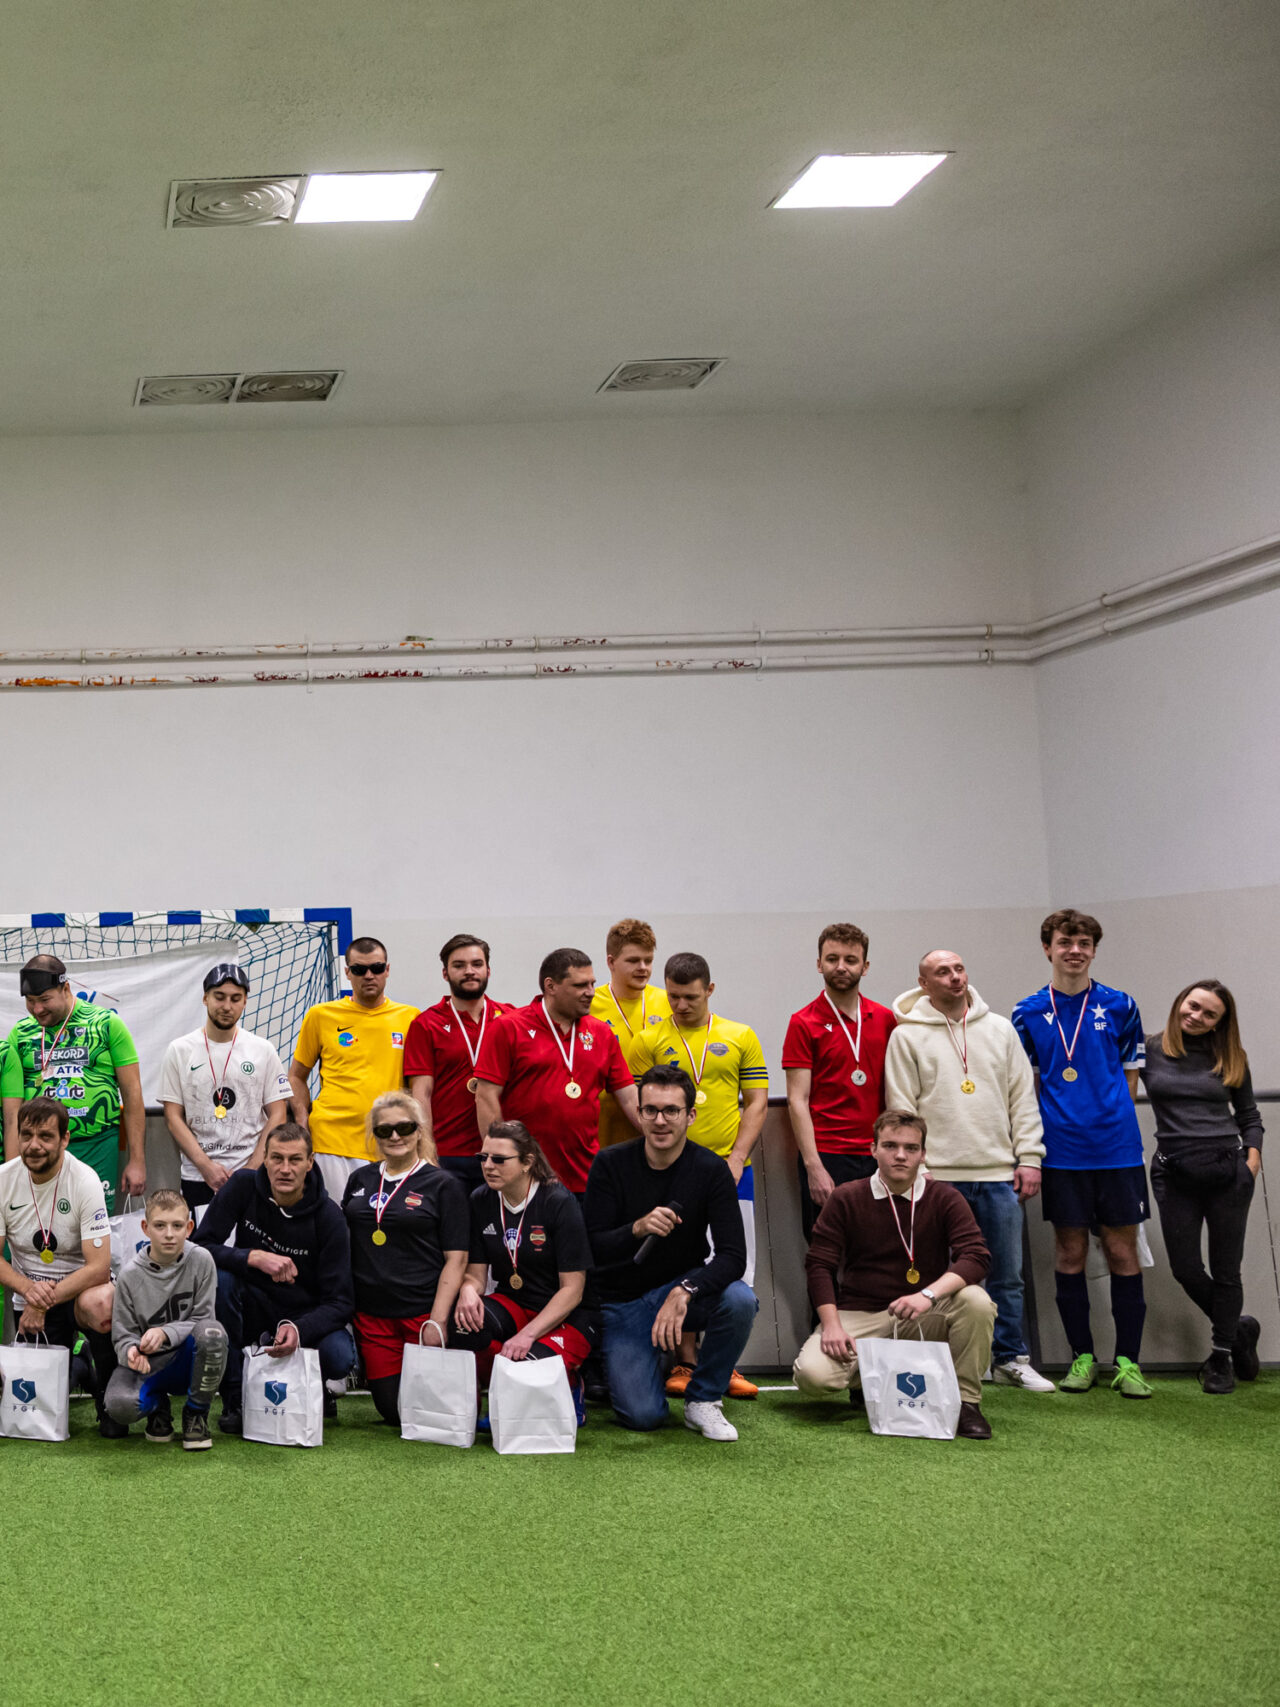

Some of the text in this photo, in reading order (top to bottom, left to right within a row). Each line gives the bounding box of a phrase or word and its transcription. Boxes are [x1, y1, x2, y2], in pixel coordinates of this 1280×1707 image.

[1094, 1021, 1107, 1031] BF
[56, 1065, 82, 1075] ATK
[273, 1241, 309, 1256] HILFIGER
